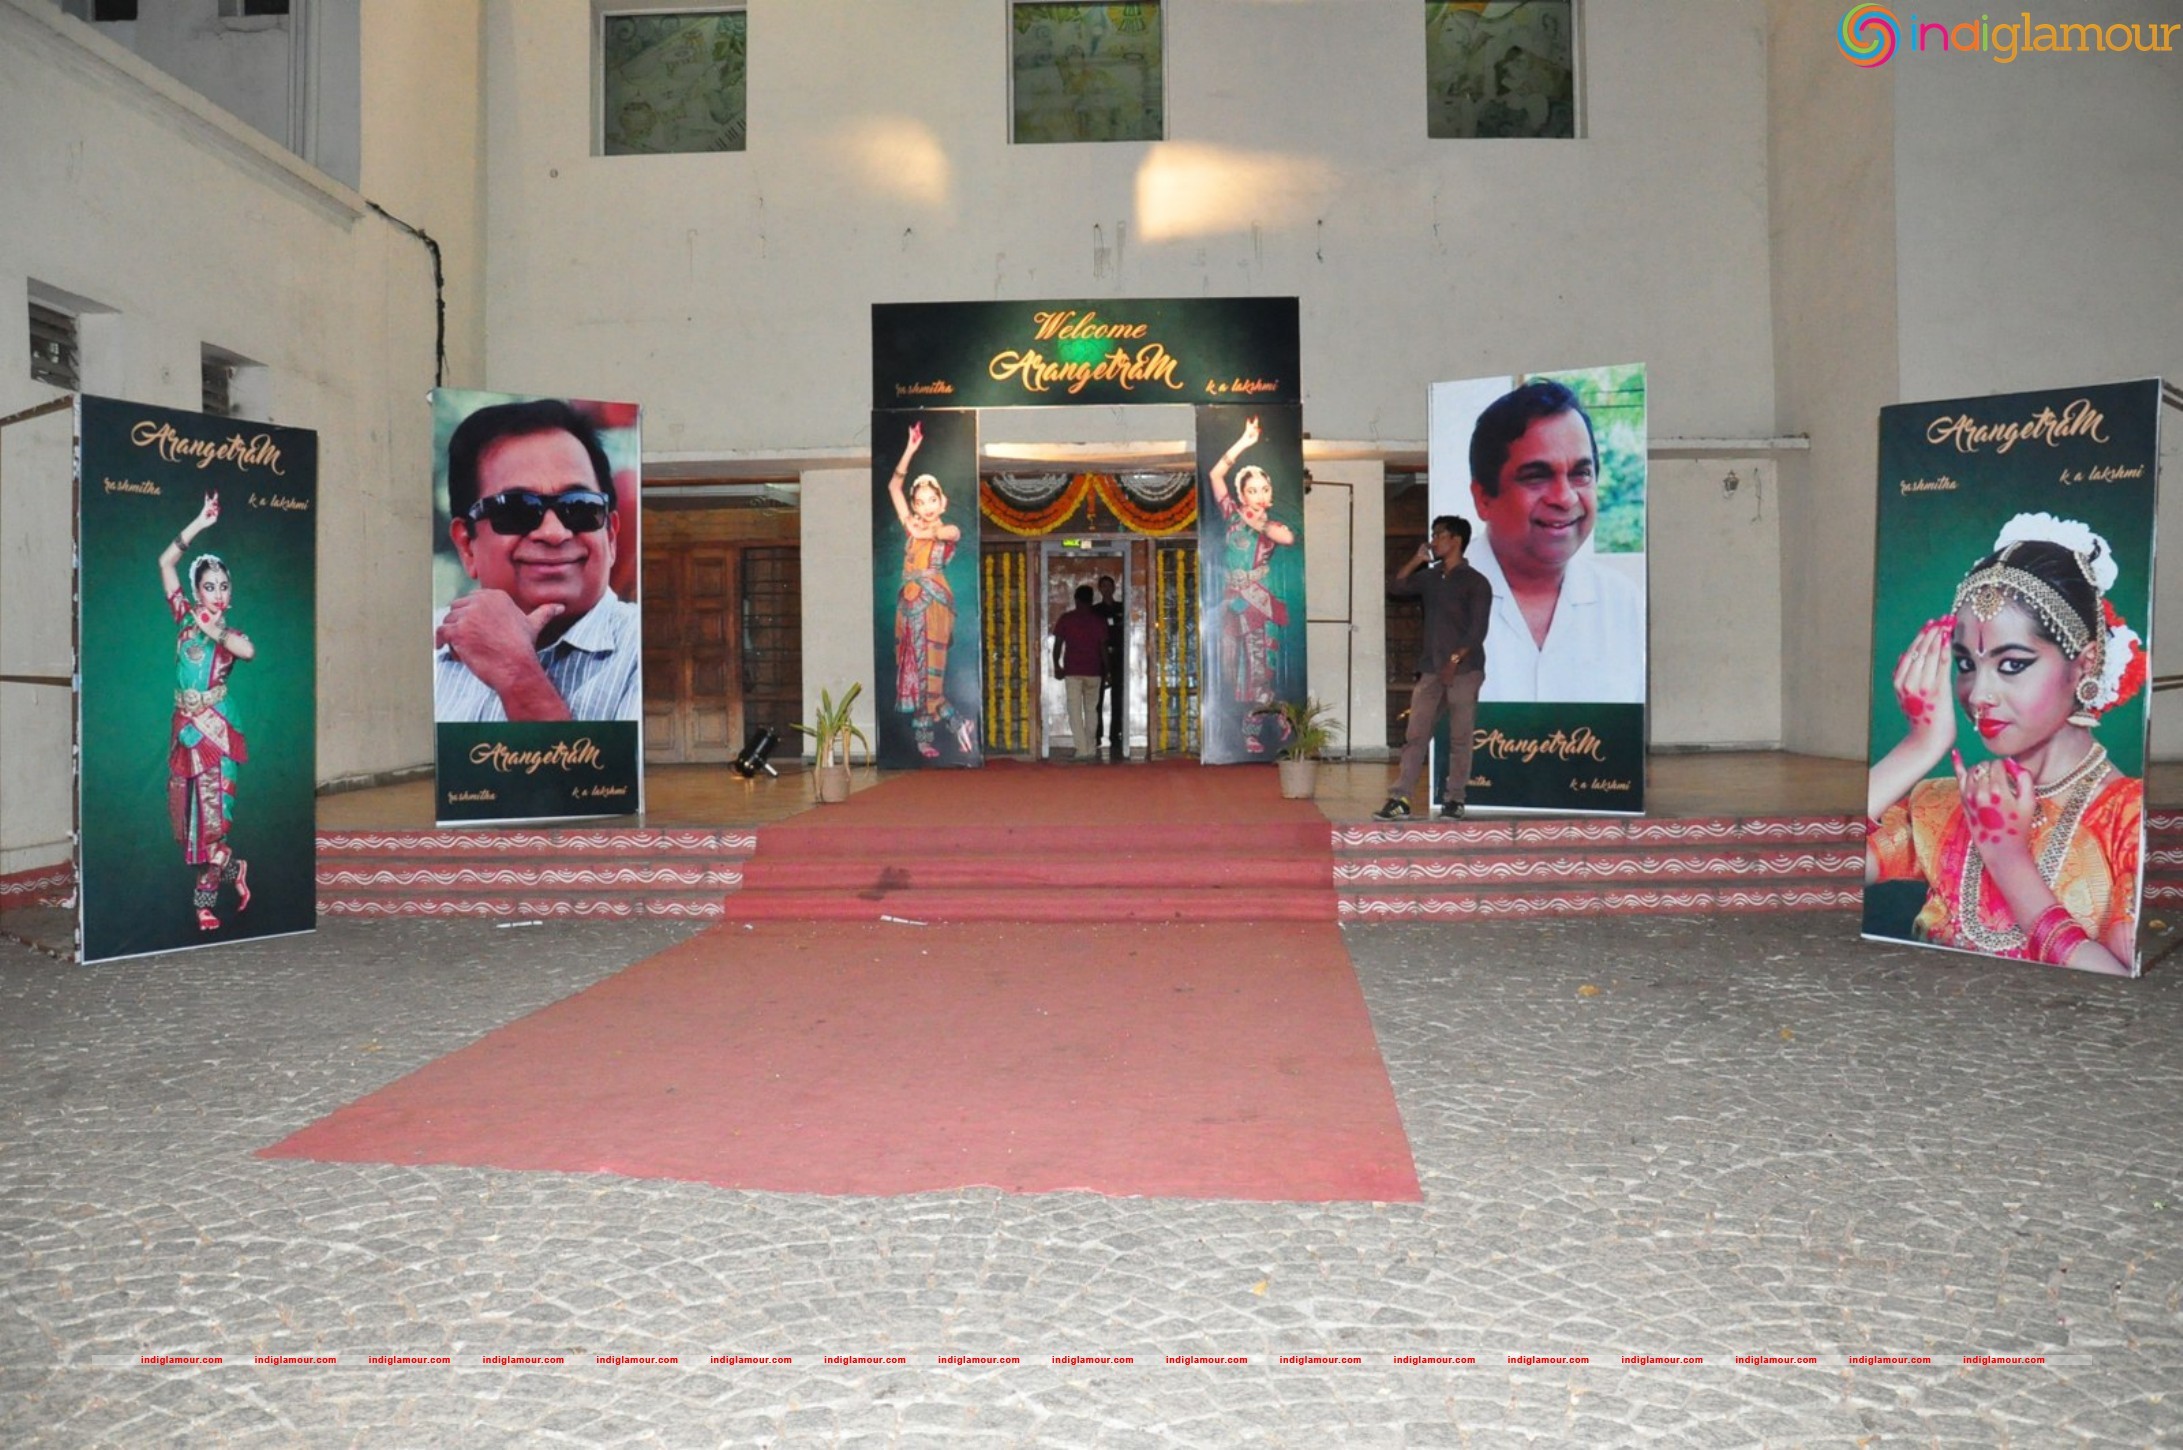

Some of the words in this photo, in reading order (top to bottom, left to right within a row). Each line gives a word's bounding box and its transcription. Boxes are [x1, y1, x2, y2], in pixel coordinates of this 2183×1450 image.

[1033, 310, 1148, 341] Welcome
[1205, 379, 1218, 396] k
[1218, 382, 1229, 392] a
[1231, 377, 1280, 395] lakshmi
[2059, 469, 2072, 485] k
[2073, 471, 2084, 482] a
[2088, 464, 2145, 483] lakshmi
[248, 493, 256, 508] k
[259, 497, 267, 506] a
[269, 494, 310, 512] lakshmi
[571, 786, 580, 800] k
[581, 789, 588, 797] a
[591, 785, 628, 799] lakshmi
[1569, 778, 1580, 792] k
[1579, 780, 1588, 789] a
[1591, 778, 1632, 793] lakshmi
